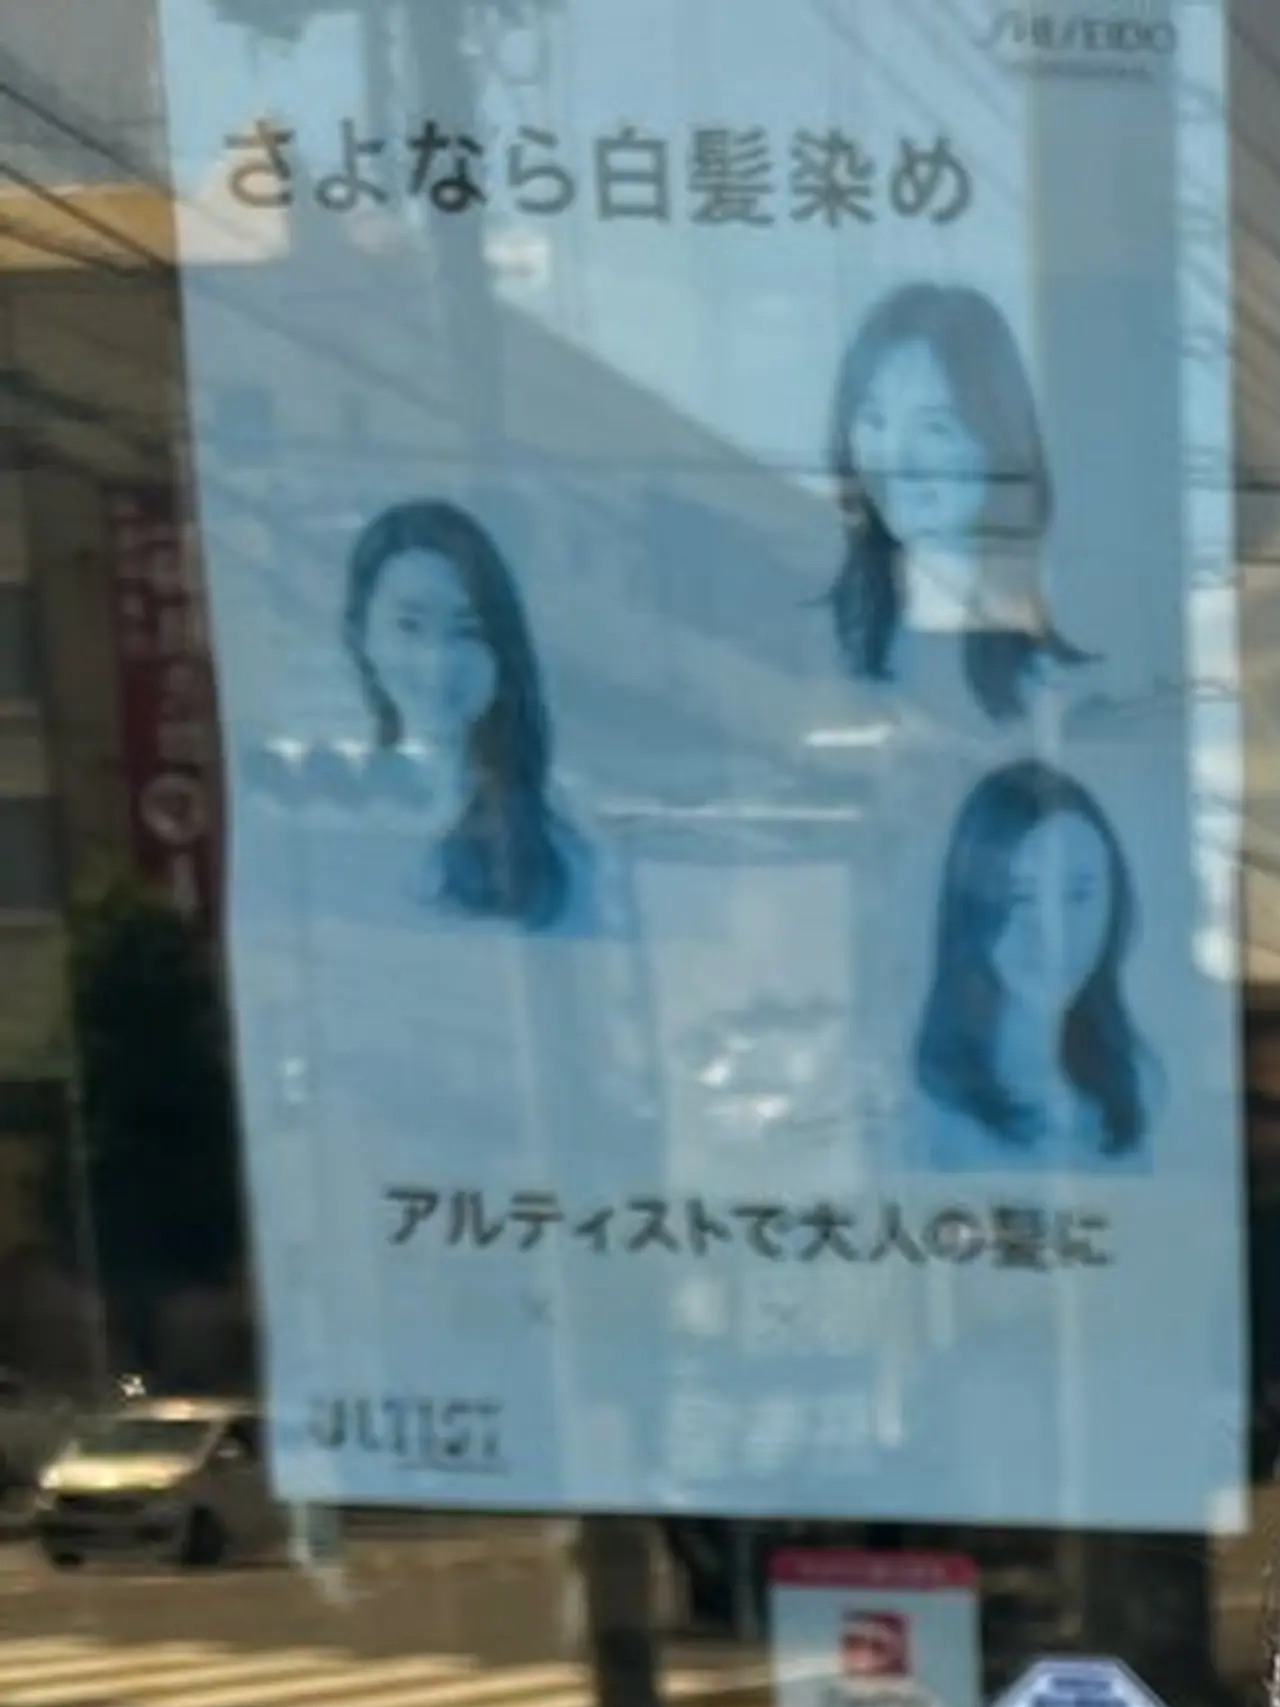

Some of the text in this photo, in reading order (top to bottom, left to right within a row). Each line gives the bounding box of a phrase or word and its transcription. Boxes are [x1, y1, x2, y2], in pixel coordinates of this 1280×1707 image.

[223, 117, 973, 228] さよなら白髪染め
[386, 1187, 1116, 1270] アルティストで大人の髪に
